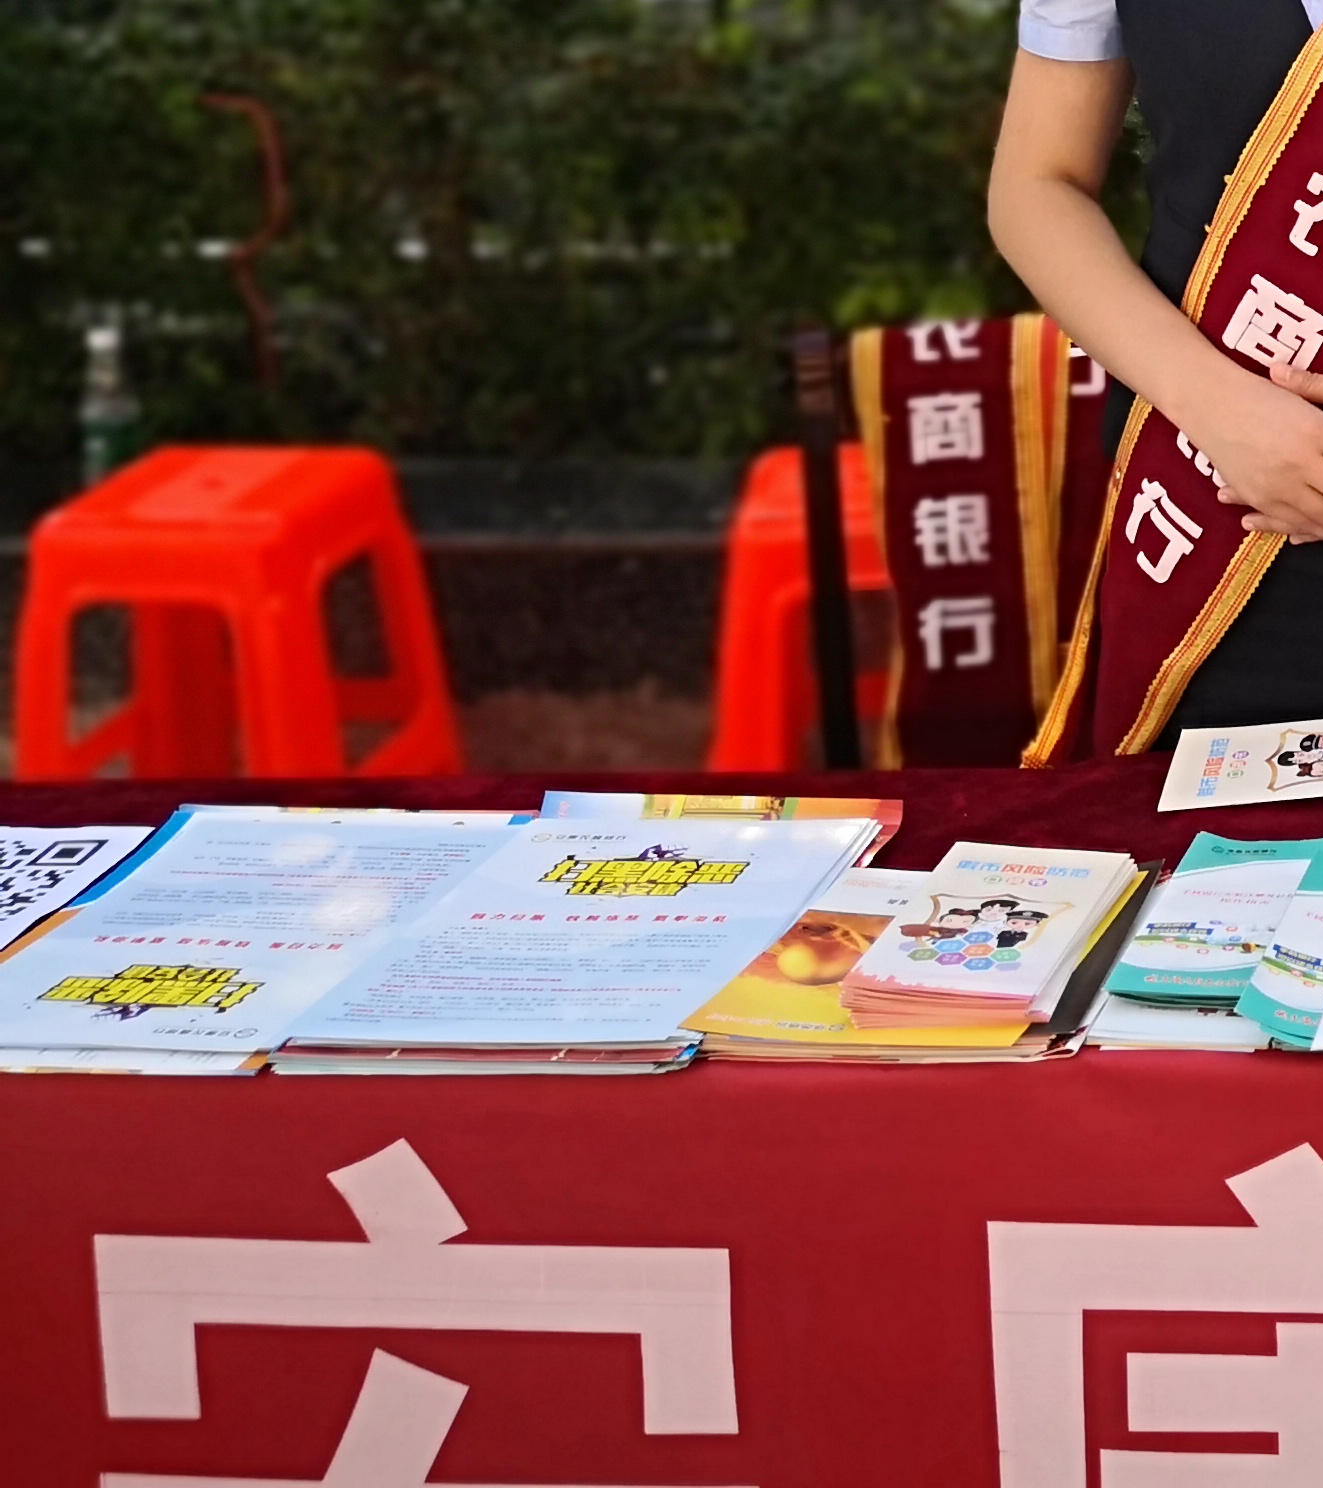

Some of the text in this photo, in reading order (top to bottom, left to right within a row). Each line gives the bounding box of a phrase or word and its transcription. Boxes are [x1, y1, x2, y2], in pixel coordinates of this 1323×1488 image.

[538, 858, 750, 885] 扫黑除恶
[36, 975, 266, 1011] 扫黑除恶
